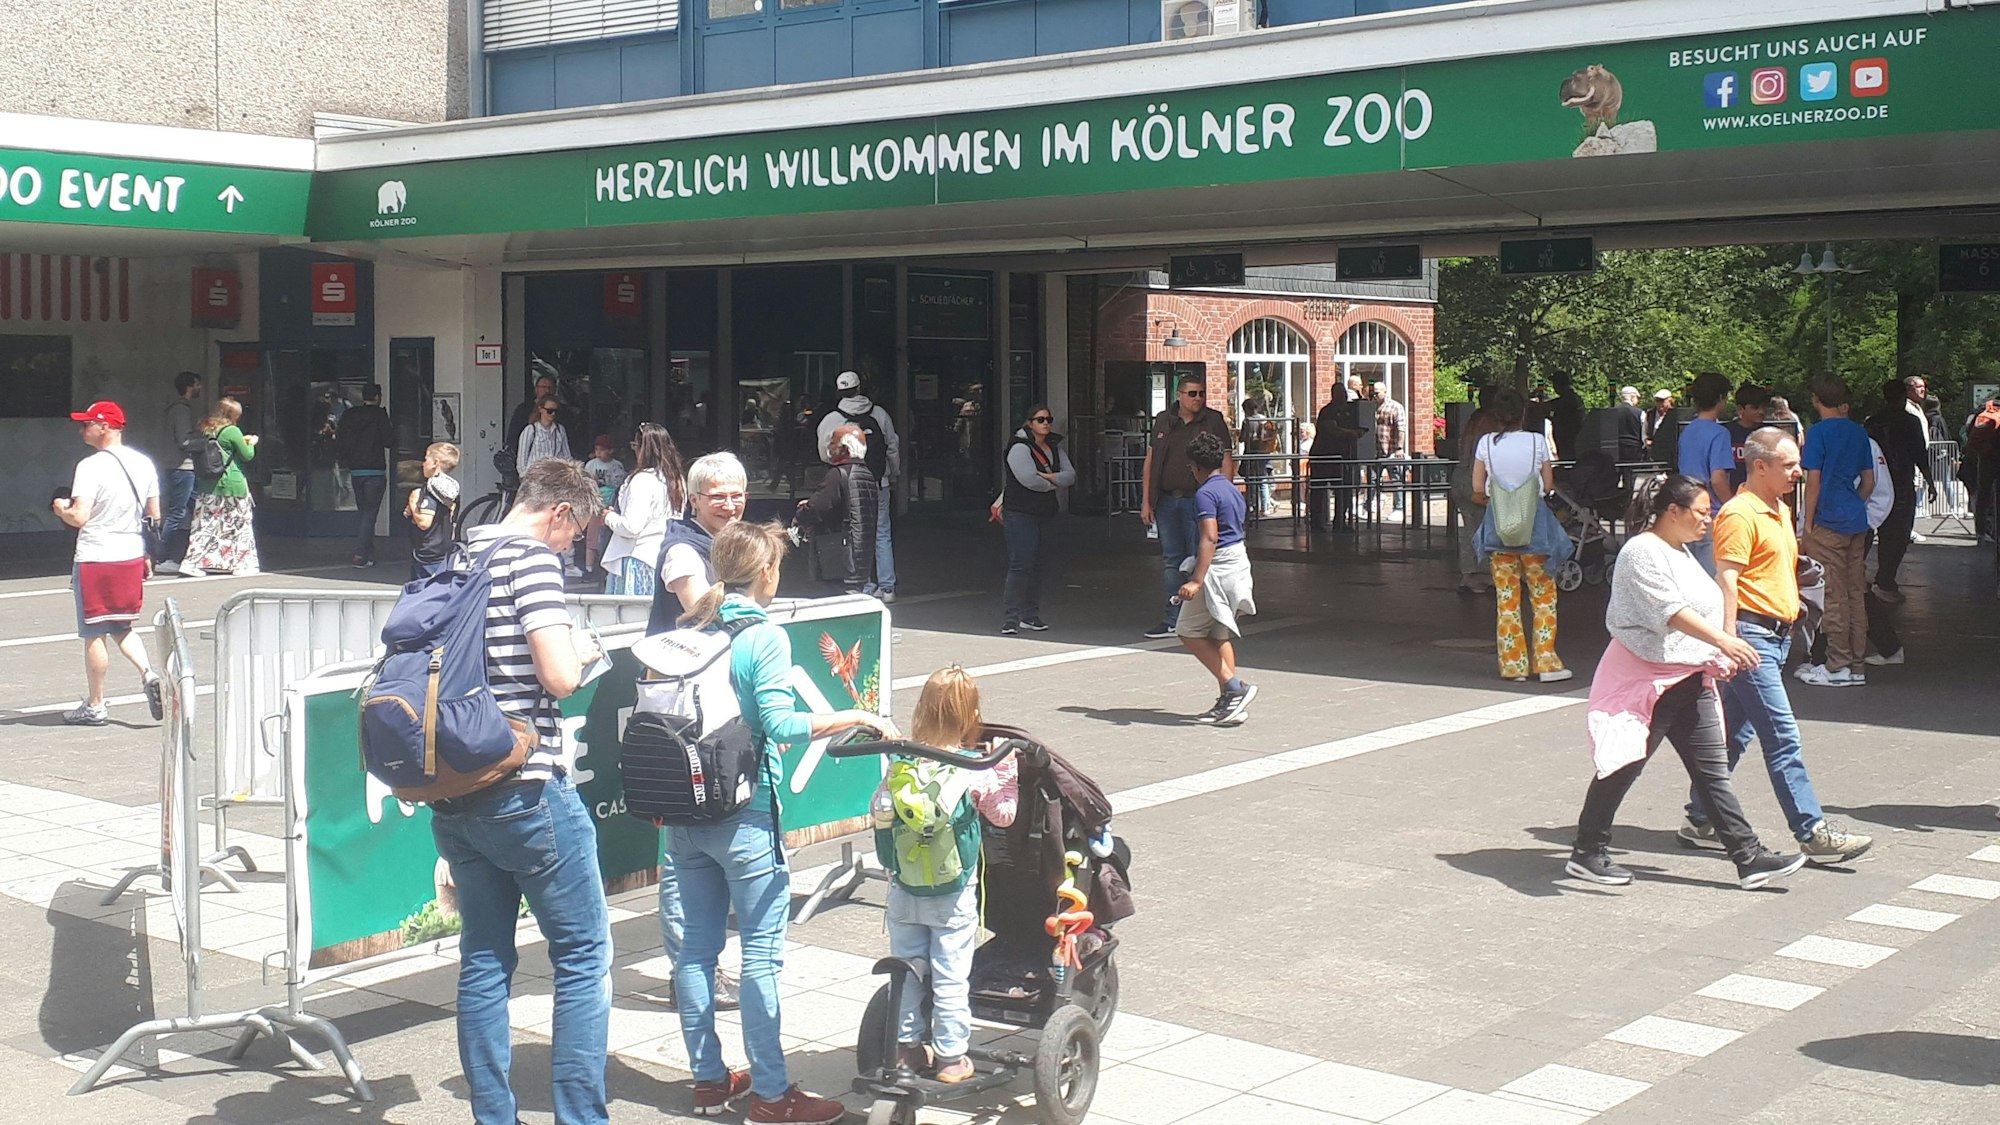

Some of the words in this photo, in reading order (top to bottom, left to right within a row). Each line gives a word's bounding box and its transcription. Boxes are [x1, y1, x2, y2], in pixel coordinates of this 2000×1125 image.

[1669, 44, 1761, 68] BESUCHT
[1766, 38, 1809, 58] UNS
[1815, 32, 1876, 54] AUCH
[1883, 27, 1928, 48] AUF
[1703, 104, 1889, 130] WWW.KOELNERZOO.DE
[596, 154, 748, 202] HERZLICH
[765, 130, 1021, 189] WILLKOMMEN
[1042, 120, 1090, 168] IM
[1111, 102, 1296, 163] KÖLNER
[1323, 88, 1433, 147] ZOO
[0, 165, 43, 206] O
[59, 168, 186, 213] EVENT
[369, 218, 400, 228] KÖLNER
[400, 217, 417, 226] ZOO
[481, 350, 490, 359] Tor
